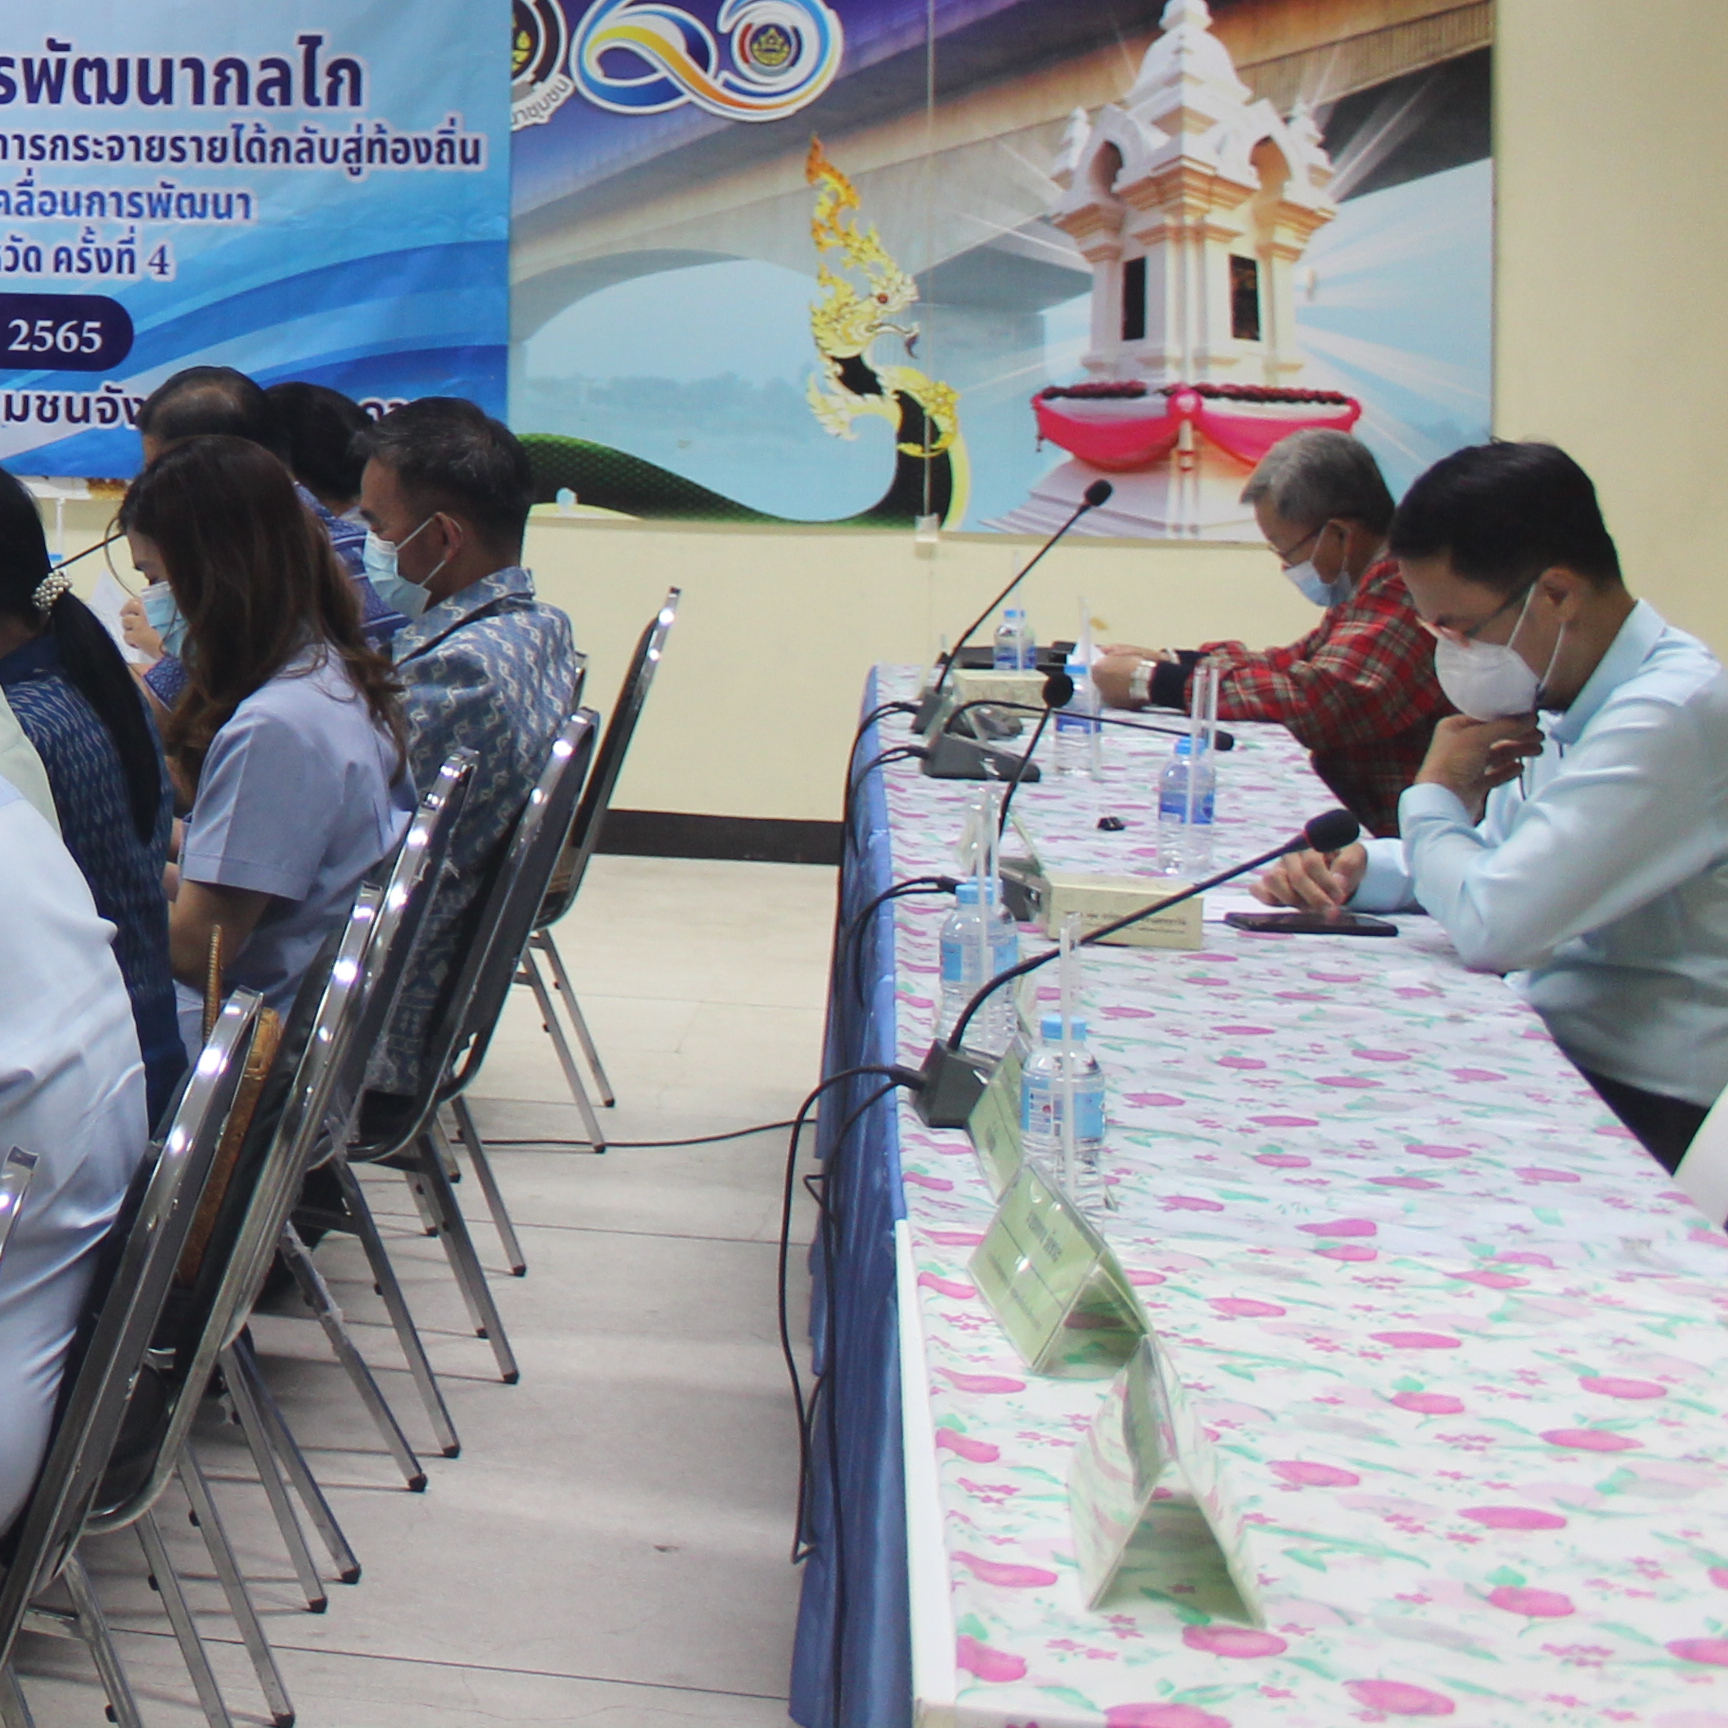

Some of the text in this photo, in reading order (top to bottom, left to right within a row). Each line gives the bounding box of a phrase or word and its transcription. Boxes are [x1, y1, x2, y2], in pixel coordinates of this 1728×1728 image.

[52, 225, 136, 276] ครั้งที่
[147, 243, 171, 276] 4
[7, 319, 104, 353] 2565
